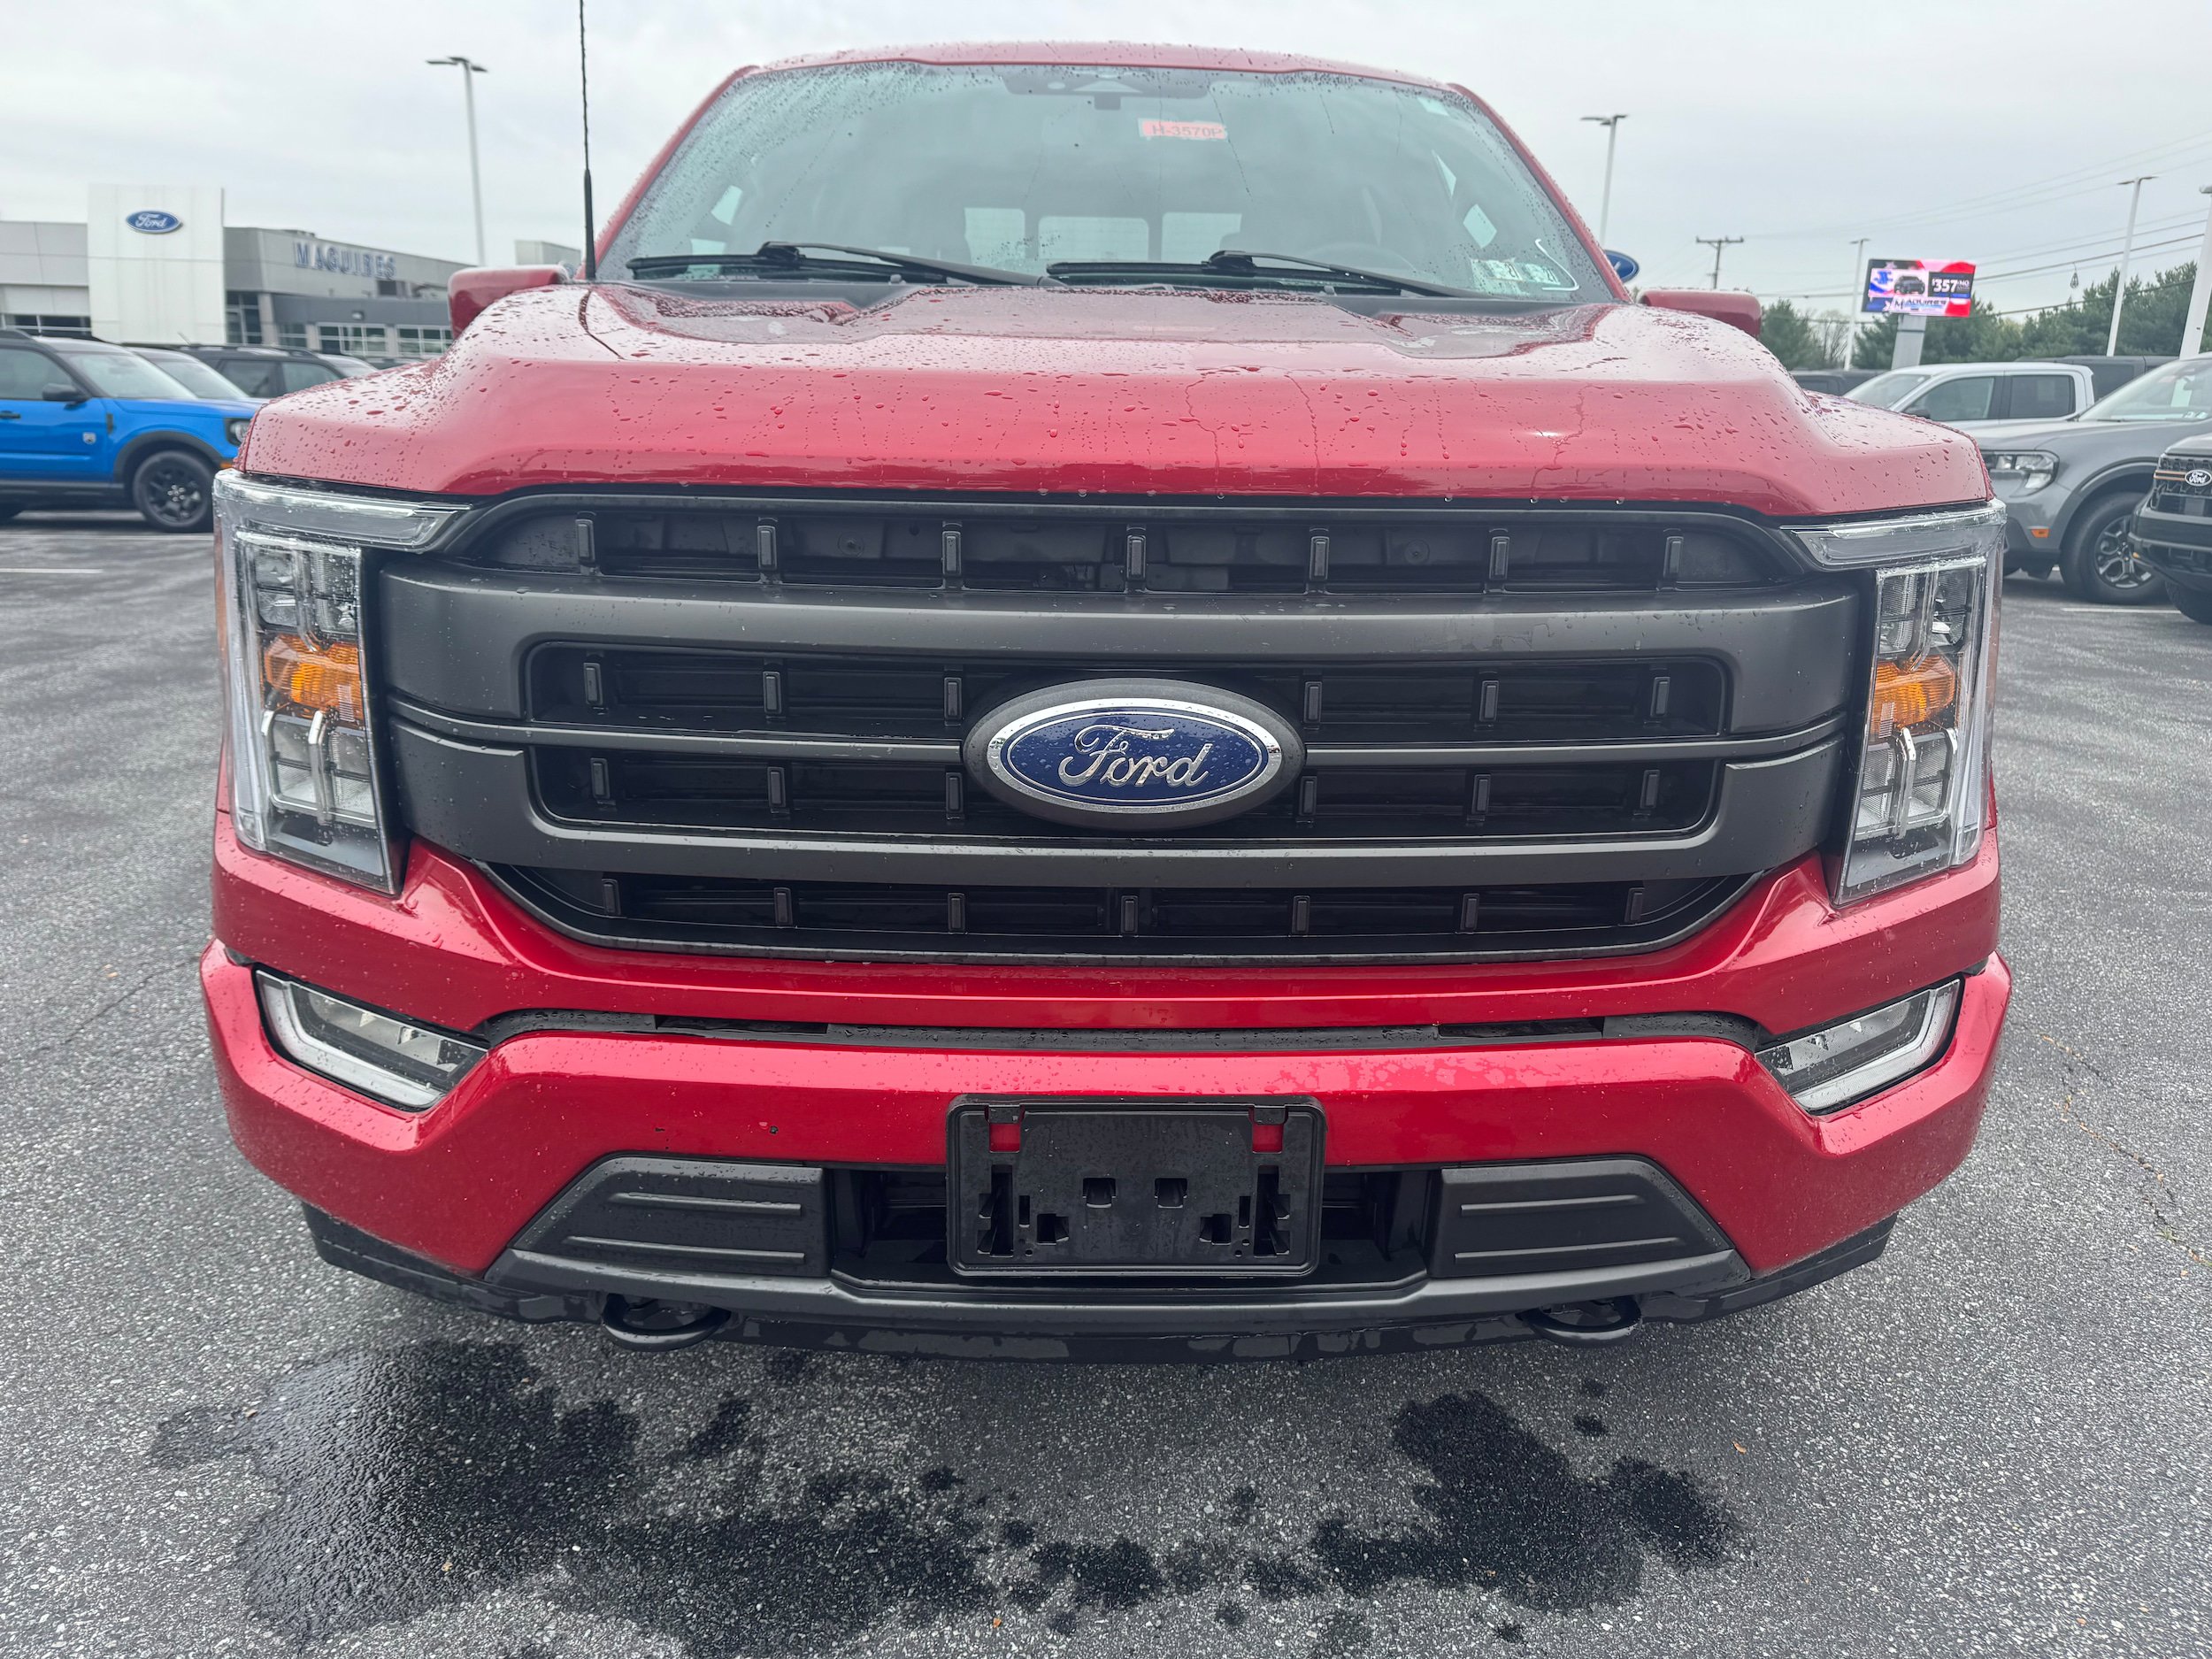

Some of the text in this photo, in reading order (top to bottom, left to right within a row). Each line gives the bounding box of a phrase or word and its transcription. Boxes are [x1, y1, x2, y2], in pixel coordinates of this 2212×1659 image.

[135, 212, 168, 228] Ford
[2188, 471, 2208, 483] Ford
[1057, 724, 1214, 787] Ford
